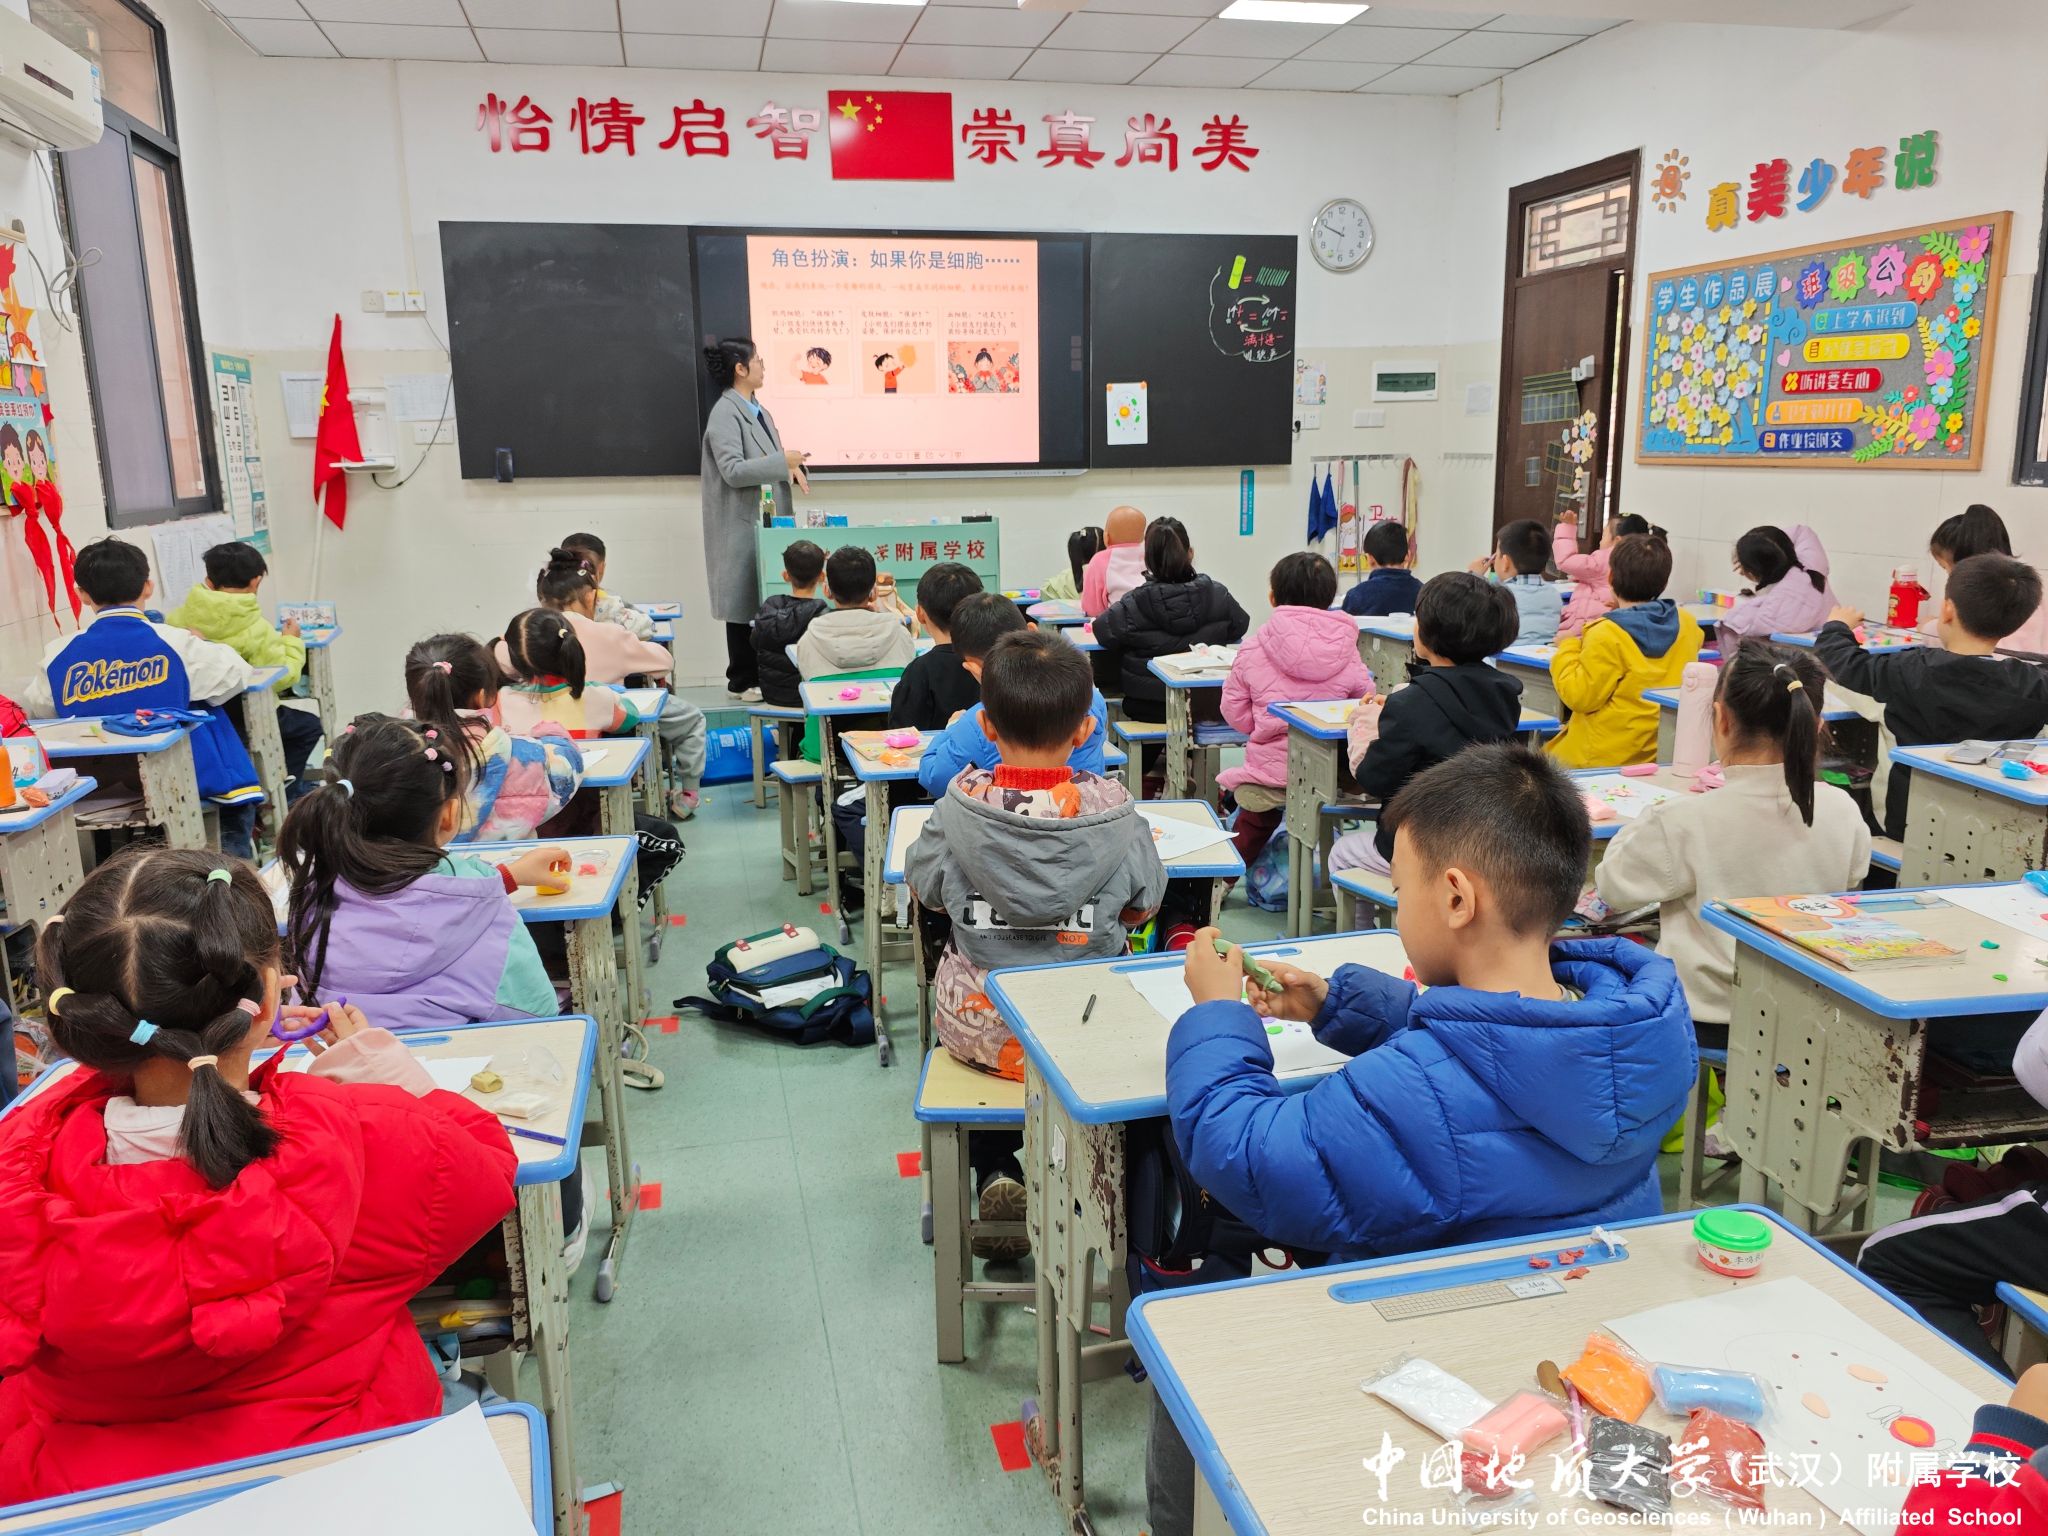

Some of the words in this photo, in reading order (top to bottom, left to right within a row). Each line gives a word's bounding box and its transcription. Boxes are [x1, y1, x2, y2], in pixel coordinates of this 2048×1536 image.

[477, 92, 822, 160] 怡情启智
[961, 107, 1260, 172] 崇真尚美
[1706, 130, 1938, 232] 真美少年说
[1658, 271, 1773, 310] 学生作品展
[1832, 306, 1905, 329] 上学不迟到
[1800, 371, 1870, 391] 听讲要专心
[1778, 431, 1843, 449] 作业按时交
[62, 655, 169, 706] Pokémon
